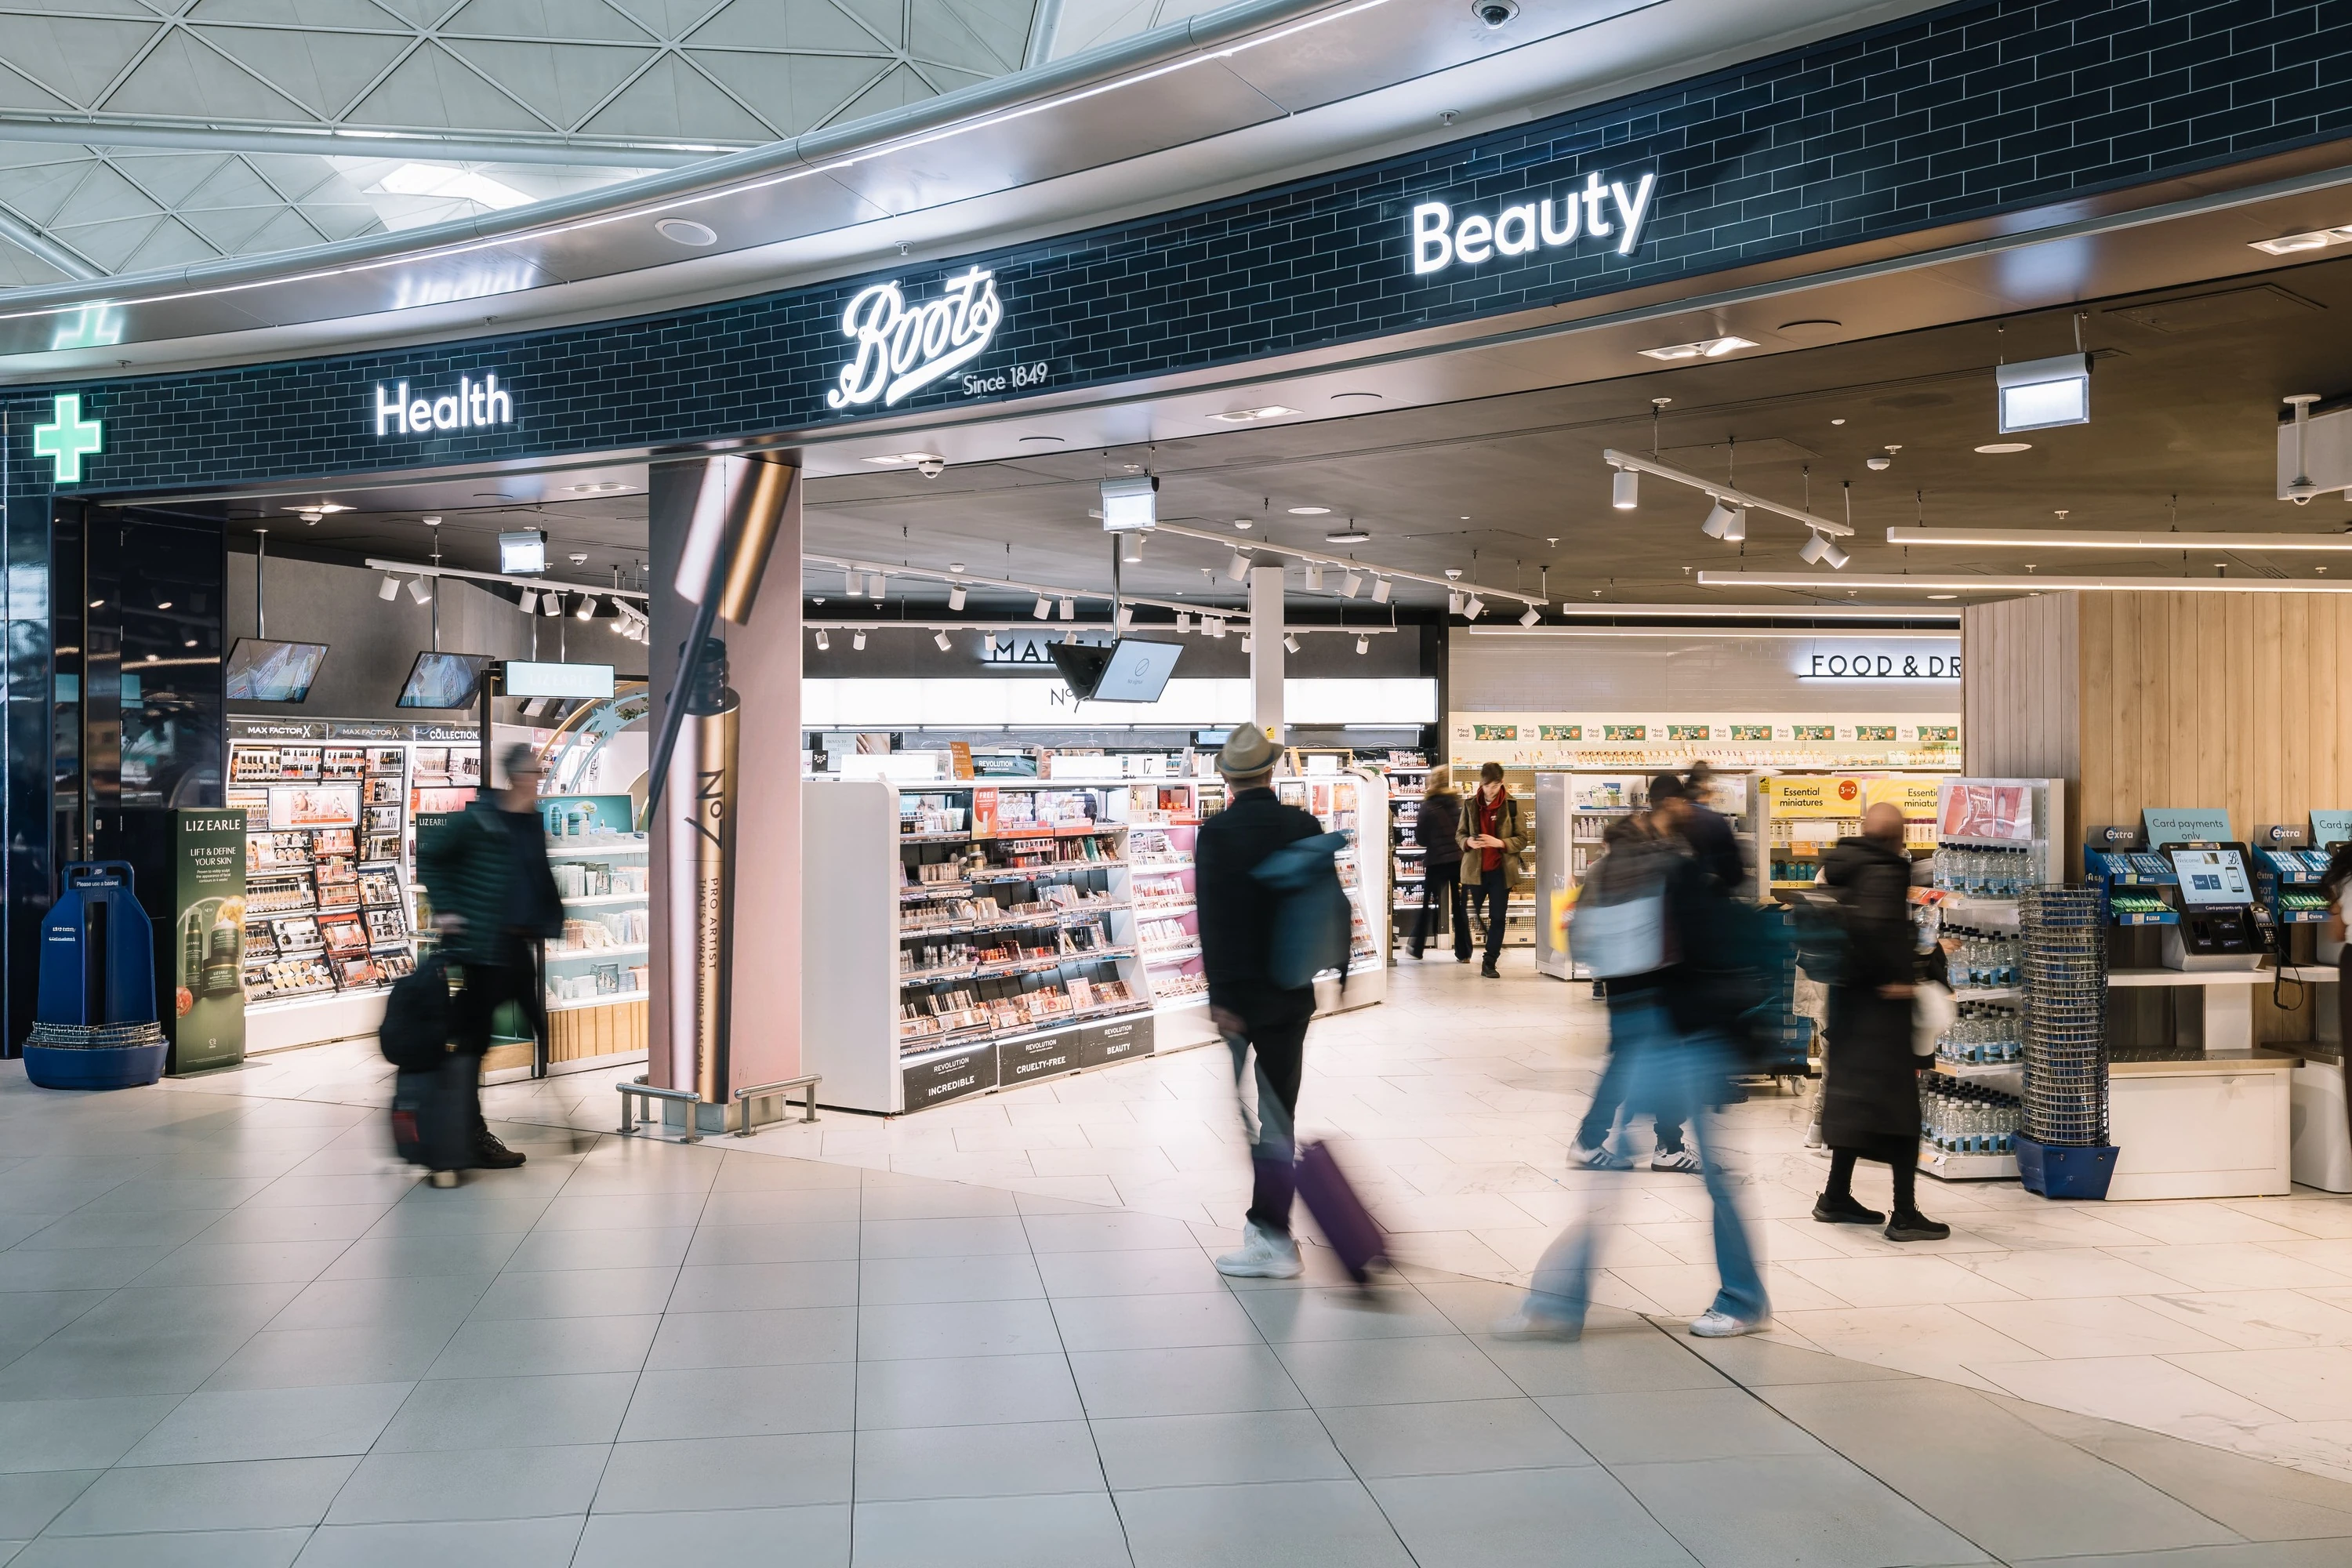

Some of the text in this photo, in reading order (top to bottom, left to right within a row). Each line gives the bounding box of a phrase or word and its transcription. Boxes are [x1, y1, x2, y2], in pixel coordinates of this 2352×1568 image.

[1414, 171, 1657, 274] Beauty
[827, 265, 1003, 408] Boots
[964, 361, 1048, 395] Since 1849
[377, 374, 512, 436] Health
[1812, 655, 1892, 677] FOOD
[1904, 655, 1920, 677] &
[530, 673, 593, 688] LIZ EARLE
[1784, 787, 1820, 797] Essential
[684, 768, 725, 850] No7
[1780, 798, 1824, 807] miniatures
[186, 819, 241, 831] LIZ EARLE
[2152, 818, 2223, 832] Card payments
[2319, 820, 2342, 829] Card
[2106, 827, 2133, 840] extra
[2273, 829, 2300, 839] extra
[213, 847, 236, 855] DEFINE
[709, 878, 718, 969] PRO ARTIST
[1104, 1024, 1133, 1036] REVOLUTION
[1025, 1039, 1057, 1051] REVOLUTION
[1107, 1043, 1131, 1054] BEAUTY
[934, 1056, 969, 1073] REVOLUTION
[928, 1075, 975, 1096] INCREDIBLE
